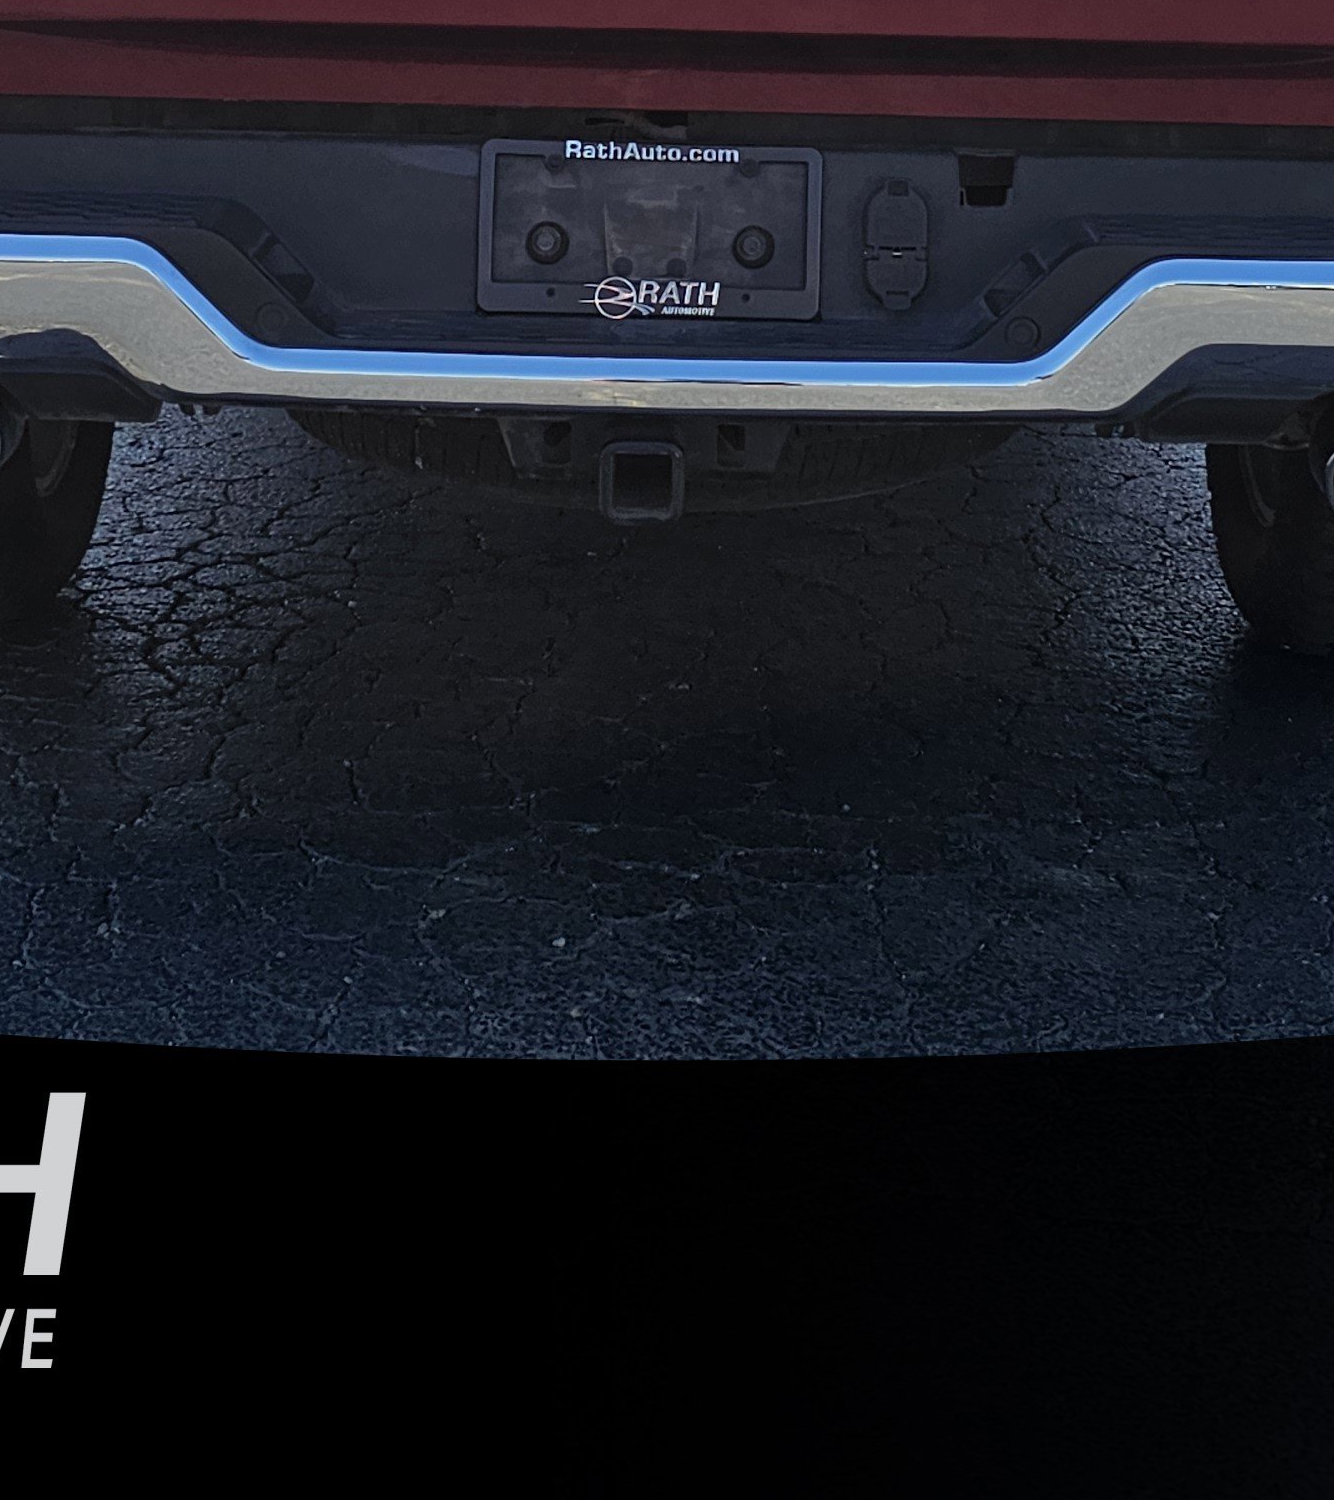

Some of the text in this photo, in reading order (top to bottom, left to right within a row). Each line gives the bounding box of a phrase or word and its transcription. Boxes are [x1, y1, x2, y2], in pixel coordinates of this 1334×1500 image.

[565, 139, 740, 163] RathAuto.com
[638, 280, 721, 306] RATH
[661, 305, 715, 317] AUTOMOTIVE
